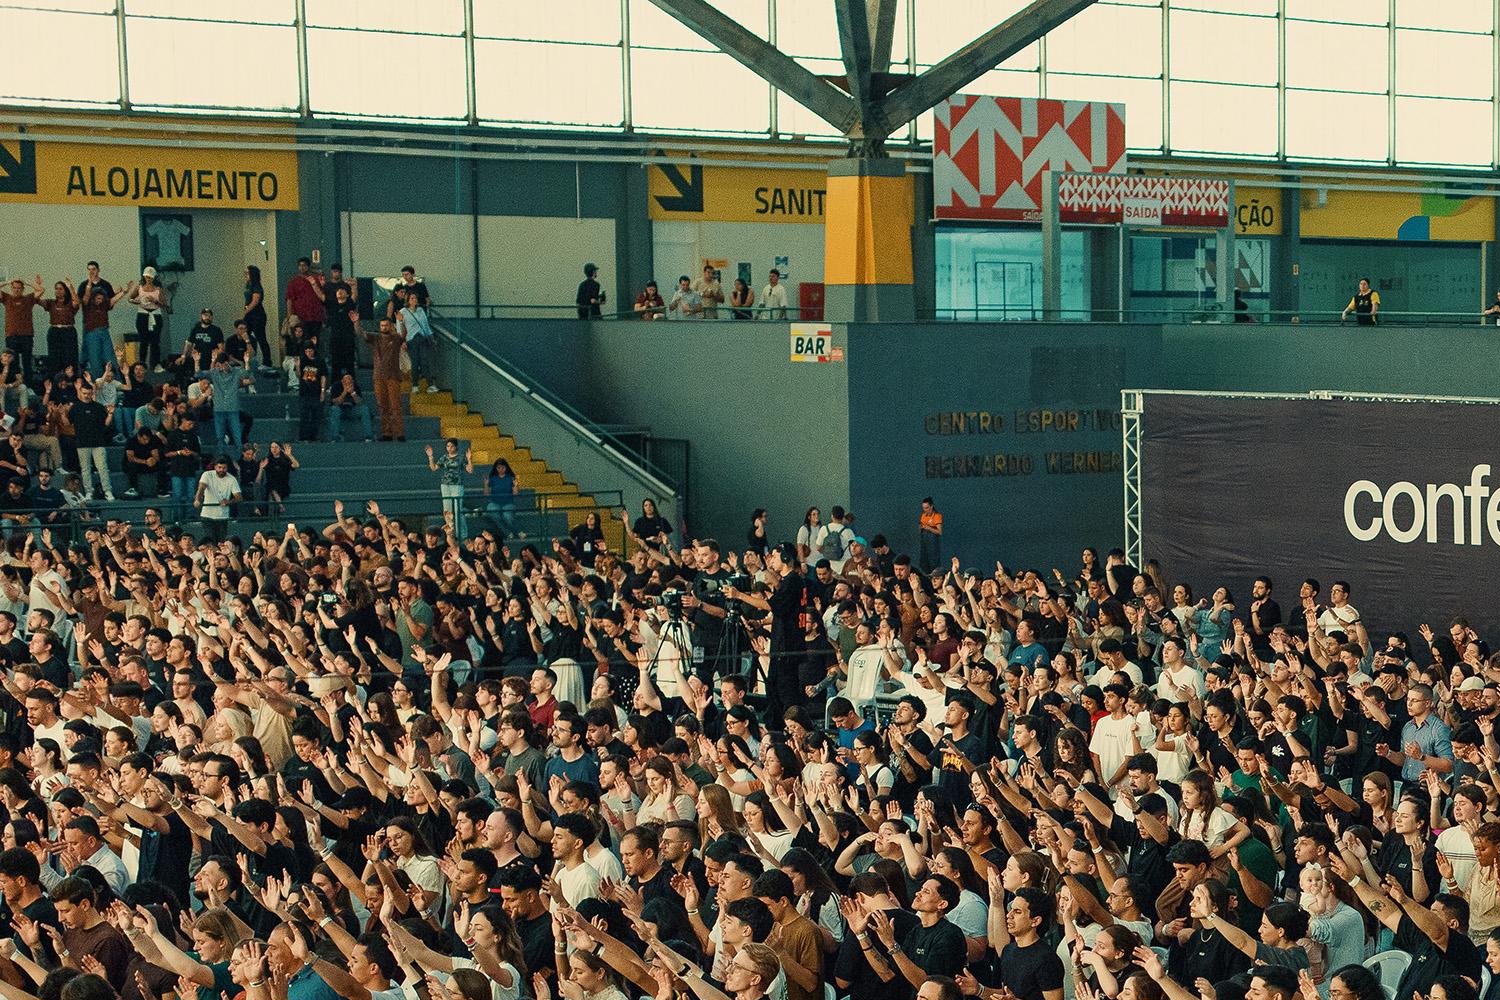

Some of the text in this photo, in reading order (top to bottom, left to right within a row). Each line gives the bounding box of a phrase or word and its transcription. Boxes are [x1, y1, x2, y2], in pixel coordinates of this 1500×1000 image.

[66, 165, 279, 202] ALOJAMENTO
[1125, 204, 1160, 219] SAÍDA
[1234, 198, 1274, 233] ÇÃO
[794, 336, 825, 355] BAR
[924, 411, 1007, 436] CENTRO
[924, 449, 1121, 479] BERNARDO WERNER
